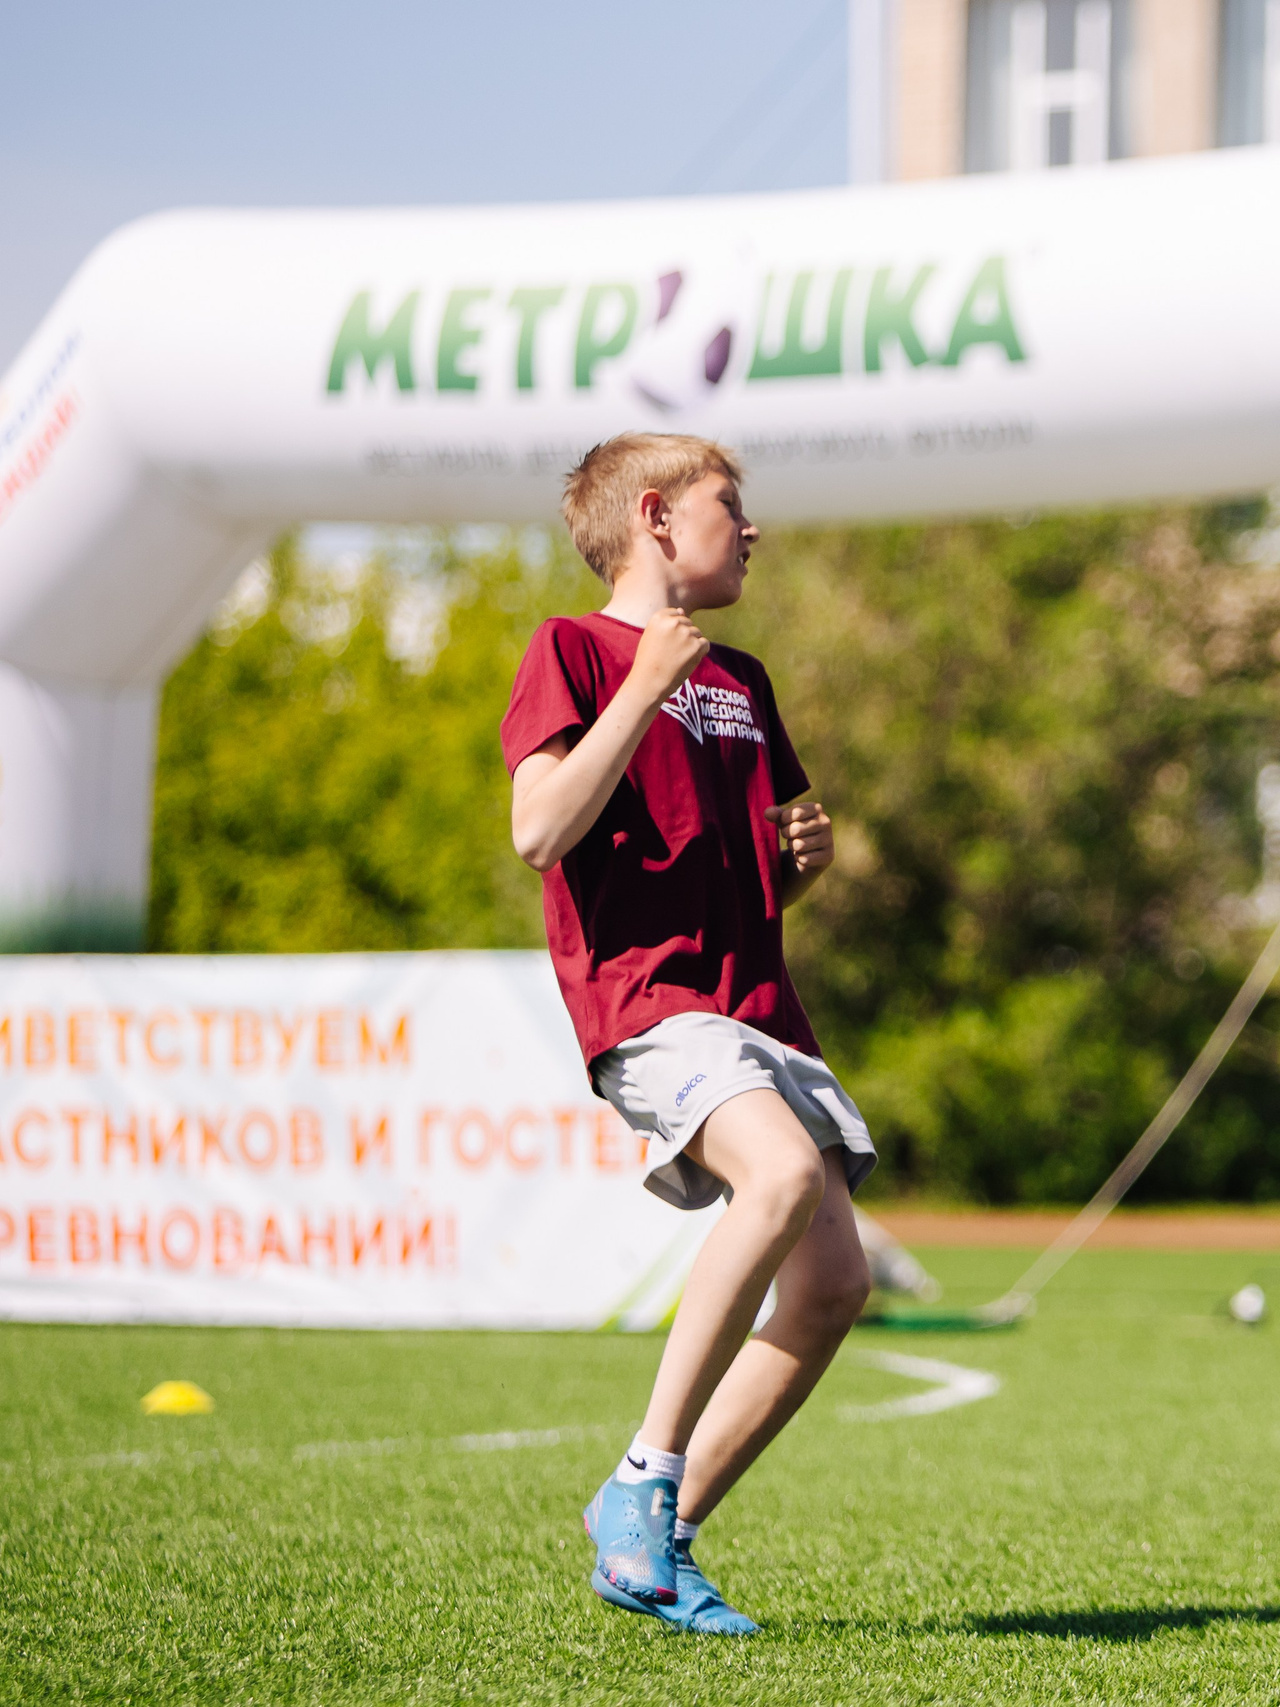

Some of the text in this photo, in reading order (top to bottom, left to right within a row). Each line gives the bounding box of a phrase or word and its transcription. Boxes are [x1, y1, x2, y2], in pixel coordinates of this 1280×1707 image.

[694, 684, 750, 709] РУССКАЯ
[700, 701, 753, 725] МЕДНАЯ
[702, 719, 766, 745] КОМПАНИ
[0, 1108, 649, 1172] СТНИКОВ И ГОСТЕ
